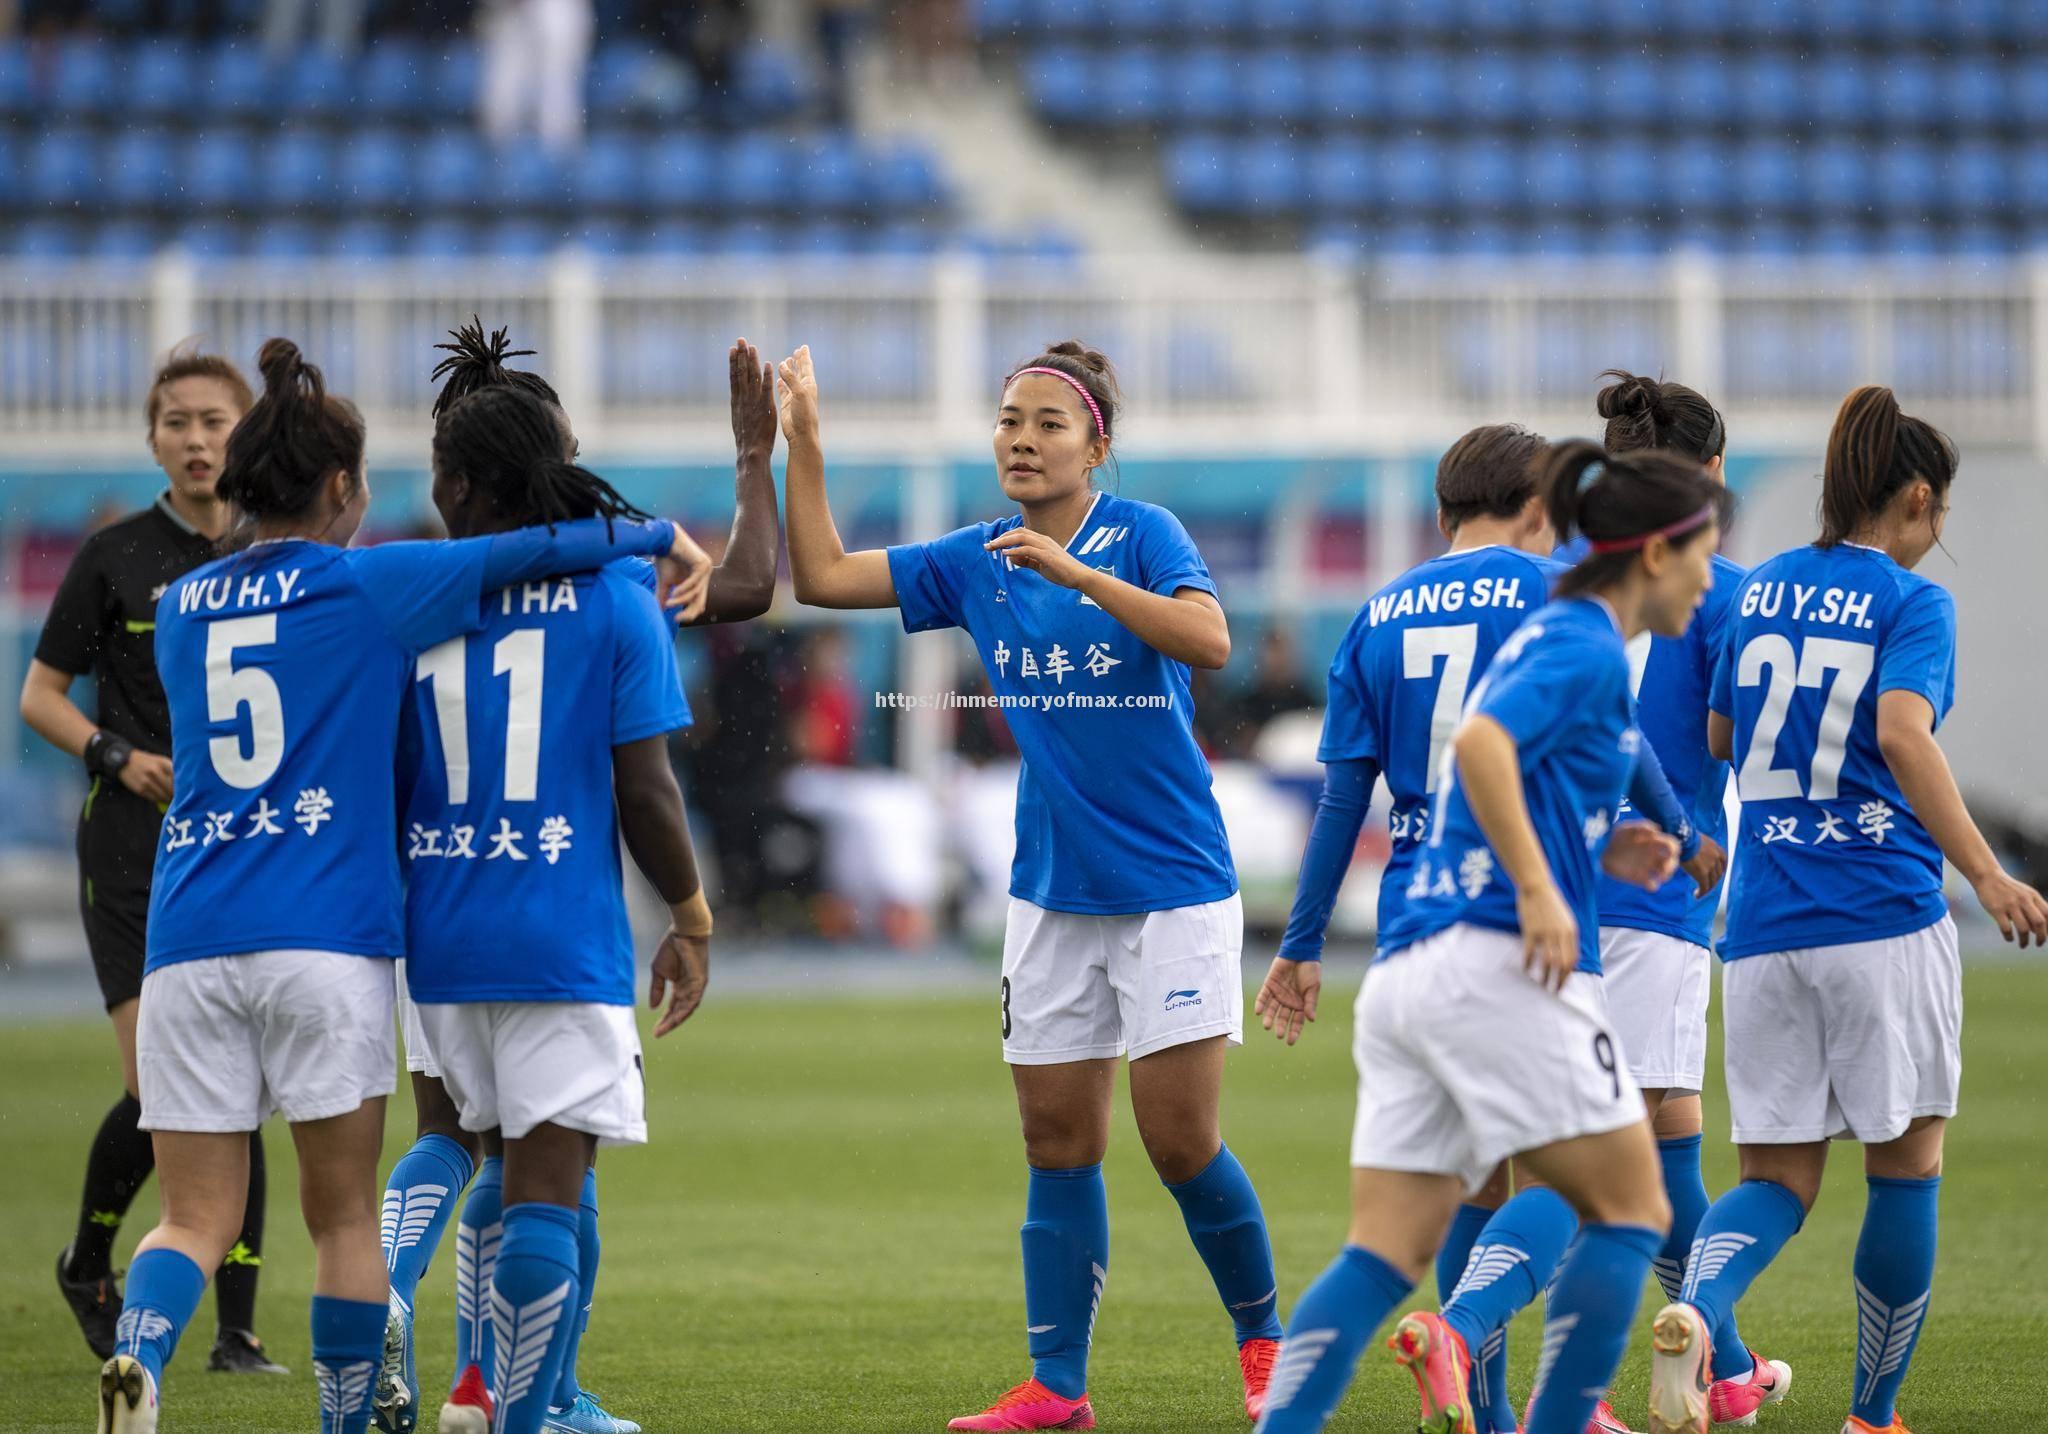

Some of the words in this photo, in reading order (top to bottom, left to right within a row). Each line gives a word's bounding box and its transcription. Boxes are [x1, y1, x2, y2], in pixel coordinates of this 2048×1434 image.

[179, 577, 232, 615] WU
[238, 569, 305, 609] H.Y.
[1369, 581, 1465, 627] WANG
[1469, 578, 1526, 609] SH.
[1741, 582, 1784, 618] GU
[994, 640, 1123, 685] 中国车谷
[205, 613, 286, 789] 5
[416, 629, 546, 805] 11
[1403, 623, 1478, 795] 7
[1737, 633, 1875, 803] 27
[166, 787, 333, 854] 江汉大学
[408, 815, 575, 866] 江汉大学
[1754, 799, 1895, 846] 汉大学
